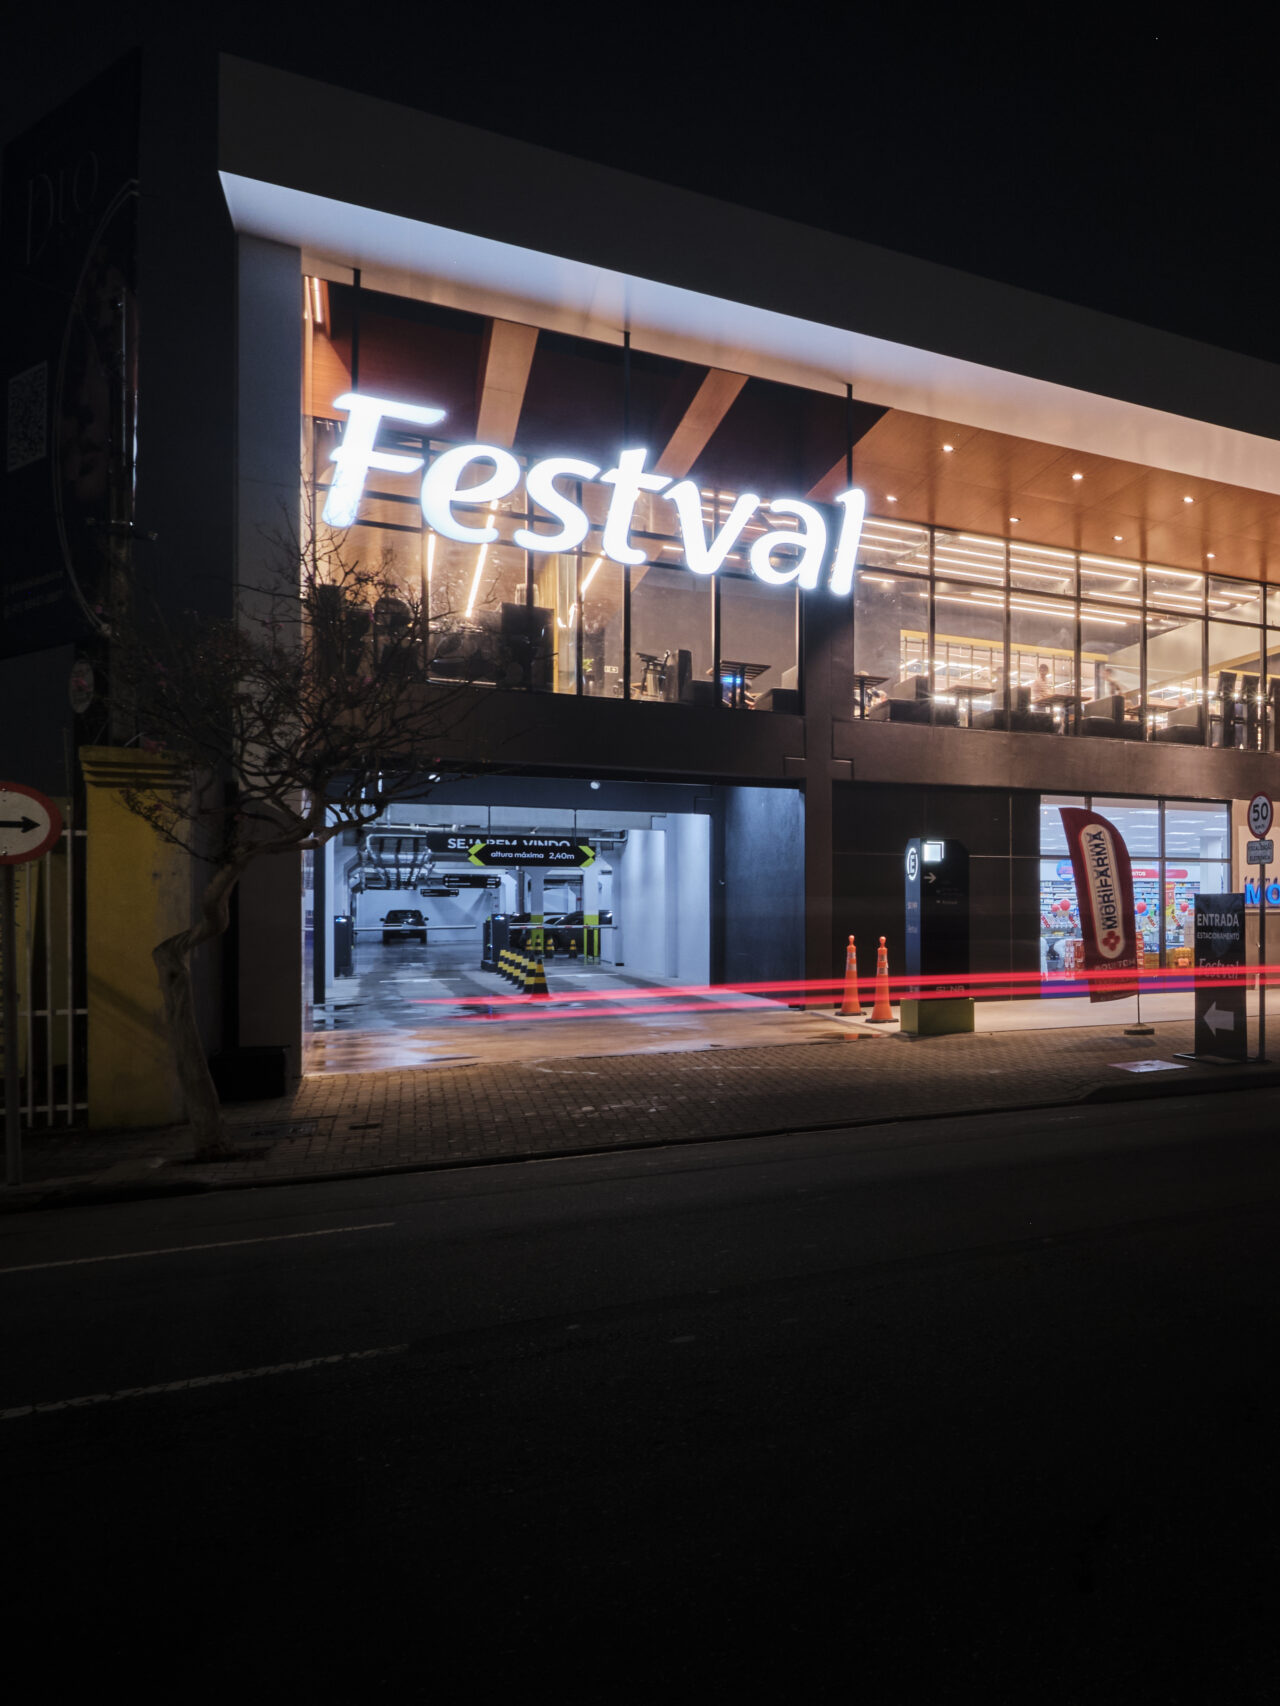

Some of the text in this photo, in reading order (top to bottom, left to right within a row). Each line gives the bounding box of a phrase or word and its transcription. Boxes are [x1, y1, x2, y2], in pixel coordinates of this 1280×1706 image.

[322, 393, 866, 596] Festval
[1252, 803, 1269, 821] 50
[514, 851, 544, 859] máxima
[549, 852, 575, 860] 2,40m
[1090, 831, 1118, 930] MORIFARMA
[1196, 913, 1240, 927] ENTRADA
[1196, 931, 1240, 941] ESTACIONAMENTO
